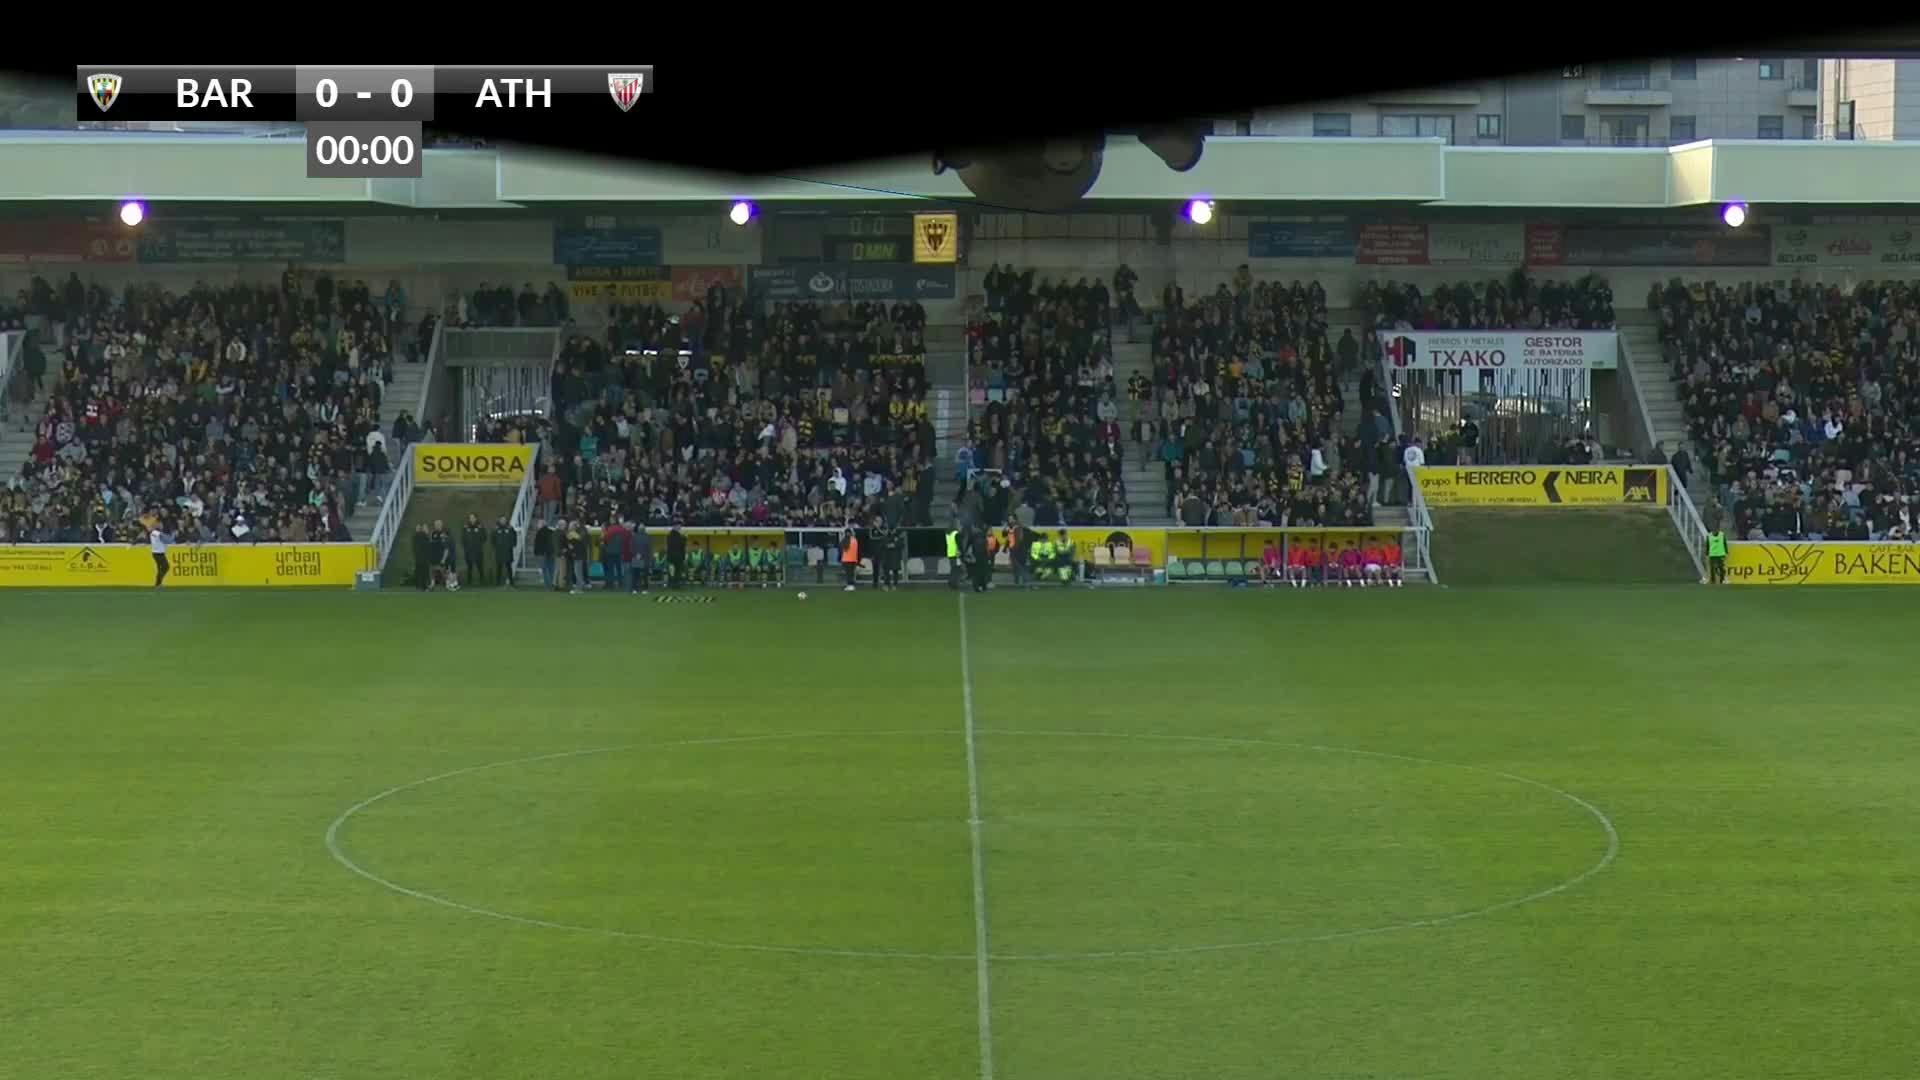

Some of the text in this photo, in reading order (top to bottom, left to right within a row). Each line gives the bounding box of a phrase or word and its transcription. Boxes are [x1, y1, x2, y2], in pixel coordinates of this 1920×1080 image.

[1471, 336, 1504, 346] METALES
[1524, 336, 1582, 347] GESTOR
[1428, 349, 1505, 367] TXAKO
[1523, 349, 1537, 357] DE
[1523, 358, 1583, 366] AUTORIZADO
[422, 455, 525, 473] SONORA
[1421, 471, 1618, 489] grupo HERRERO NEIRA
[172, 547, 218, 564] urban
[275, 547, 321, 563] urban
[172, 563, 218, 577] dental
[276, 562, 321, 576] dental
[1725, 564, 1809, 580] rup La Pau
